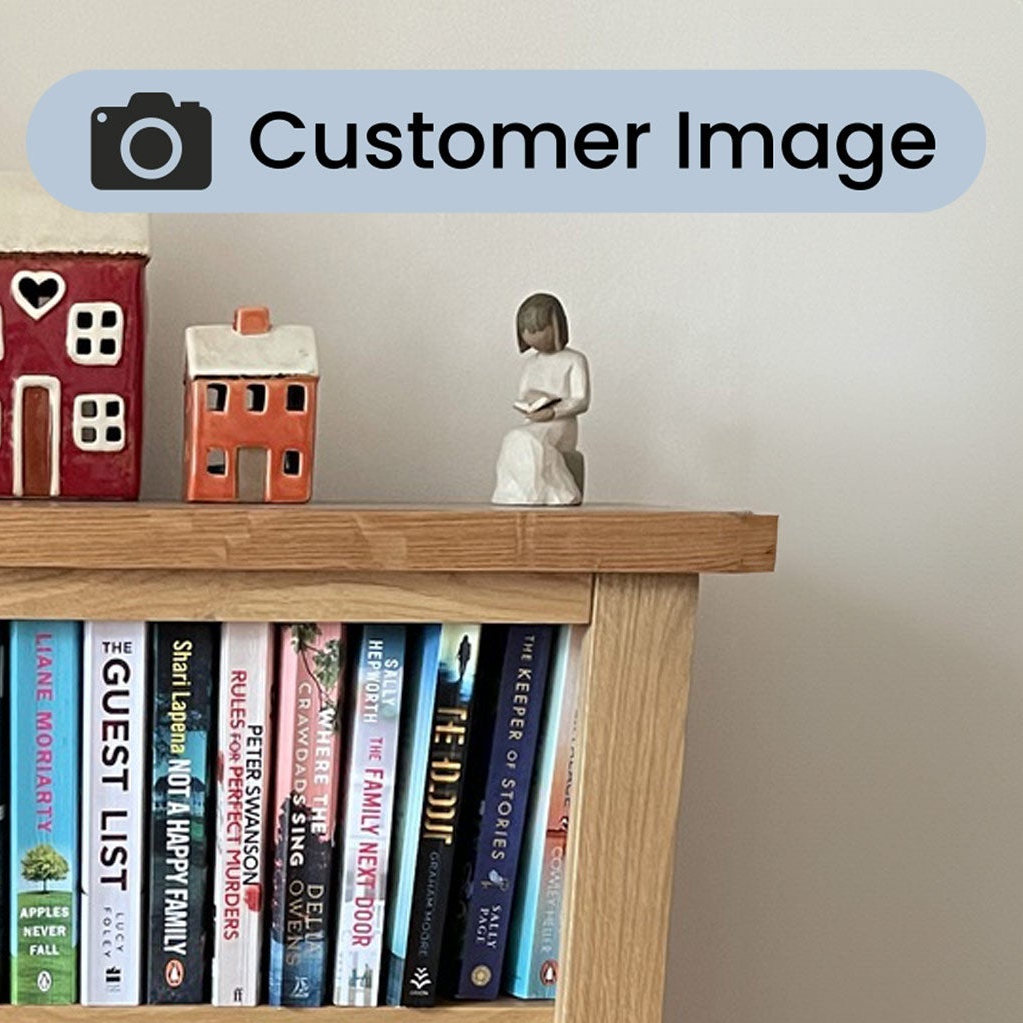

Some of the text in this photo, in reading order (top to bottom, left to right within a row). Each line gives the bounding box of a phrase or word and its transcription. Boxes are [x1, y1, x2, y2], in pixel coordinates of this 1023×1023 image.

[102, 641, 133, 655] THE
[168, 640, 193, 755] Shari Lapena
[382, 659, 399, 706] SALLY
[35, 633, 53, 834] LIANE MORIARTY
[99, 658, 131, 891] GUEST LIST
[289, 682, 312, 867] CRAWDADS SING
[314, 706, 337, 785] WHERE
[491, 635, 535, 860] THE KEEPER OF STORIES
[223, 670, 248, 941] RULES FOR PERFECT MURDERS
[242, 725, 263, 885] PETER SWANSON
[352, 738, 384, 948] THE FAMILY NEXT DOOR
[163, 758, 191, 956] NOT A HAPPY FAMILY
[20, 905, 70, 919] APPLES
[23, 925, 68, 937] NEVER
[29, 944, 60, 956] FALL
[114, 912, 124, 952] LUCY
[285, 880, 304, 966] OWENS
[487, 905, 501, 949] SALLY
